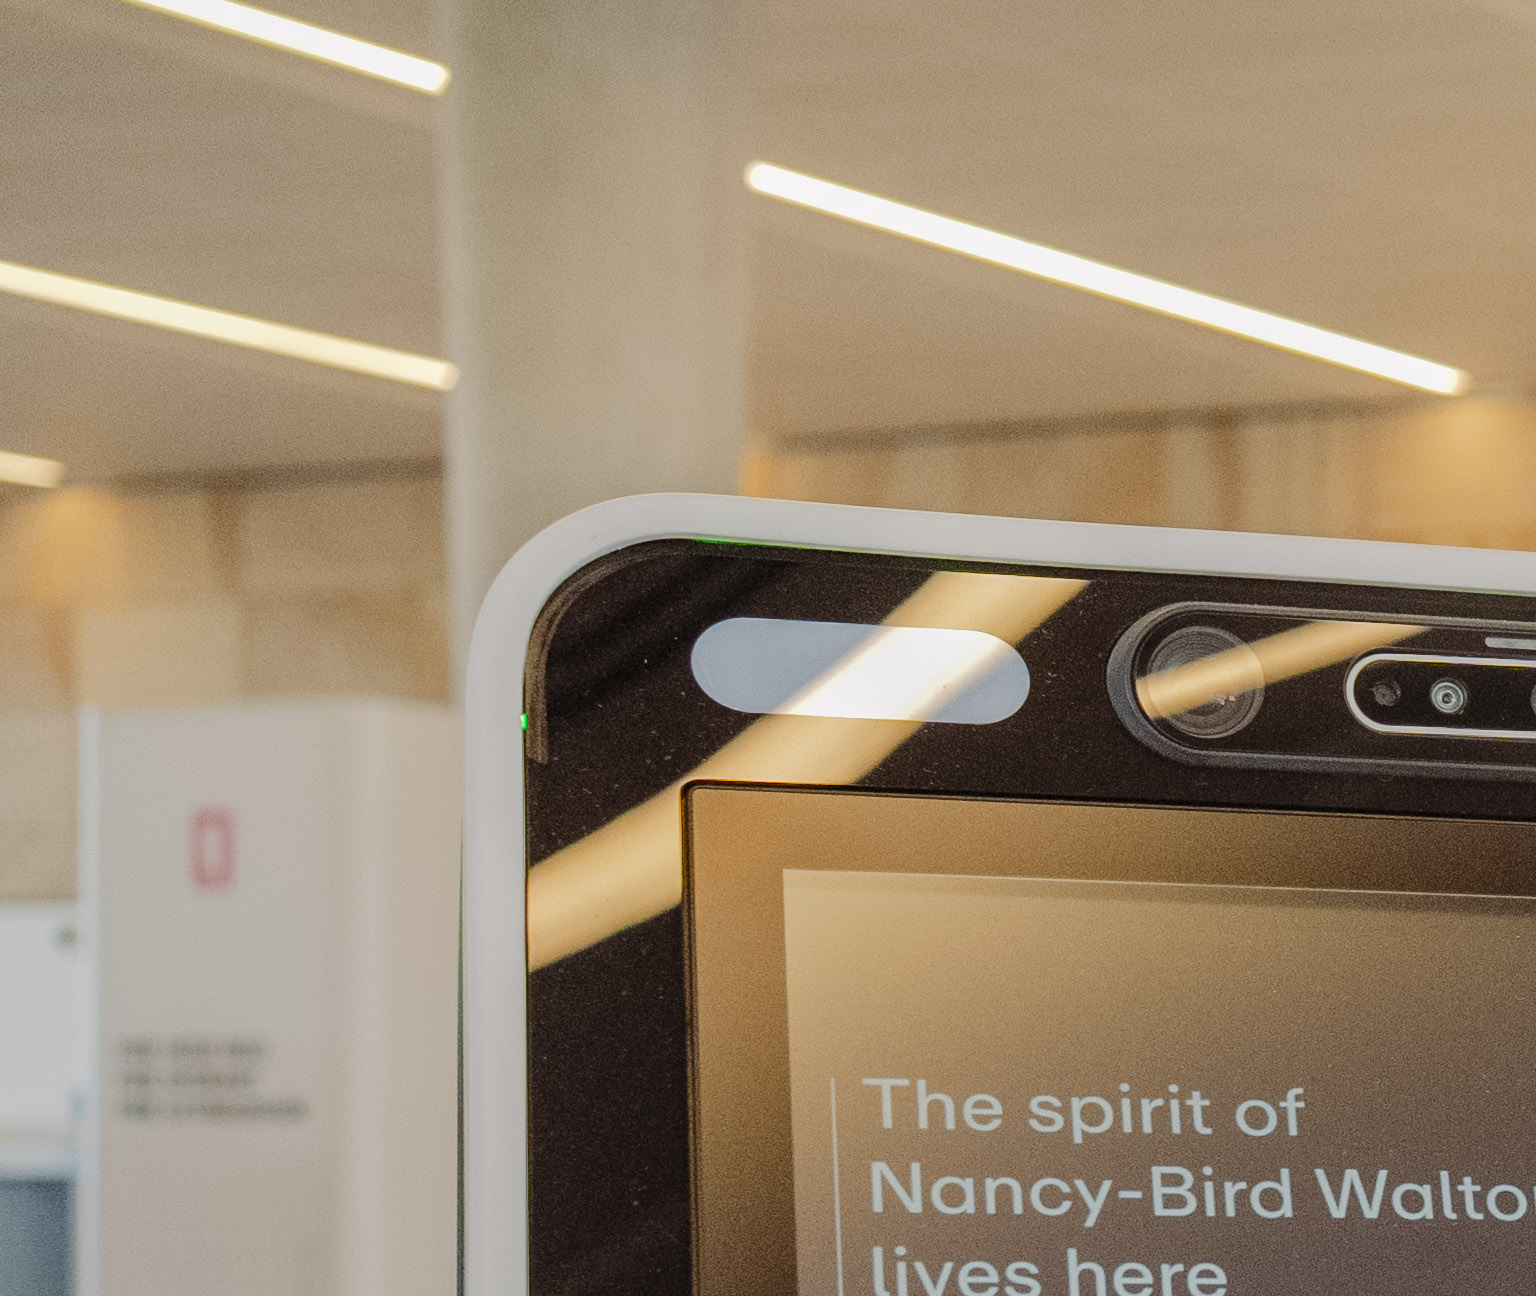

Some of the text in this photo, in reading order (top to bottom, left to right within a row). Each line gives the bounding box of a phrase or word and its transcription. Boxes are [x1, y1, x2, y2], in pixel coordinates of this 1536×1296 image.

[861, 1076, 1306, 1145] The spirit of
[870, 1160, 1294, 1228] Nancy-Bird
